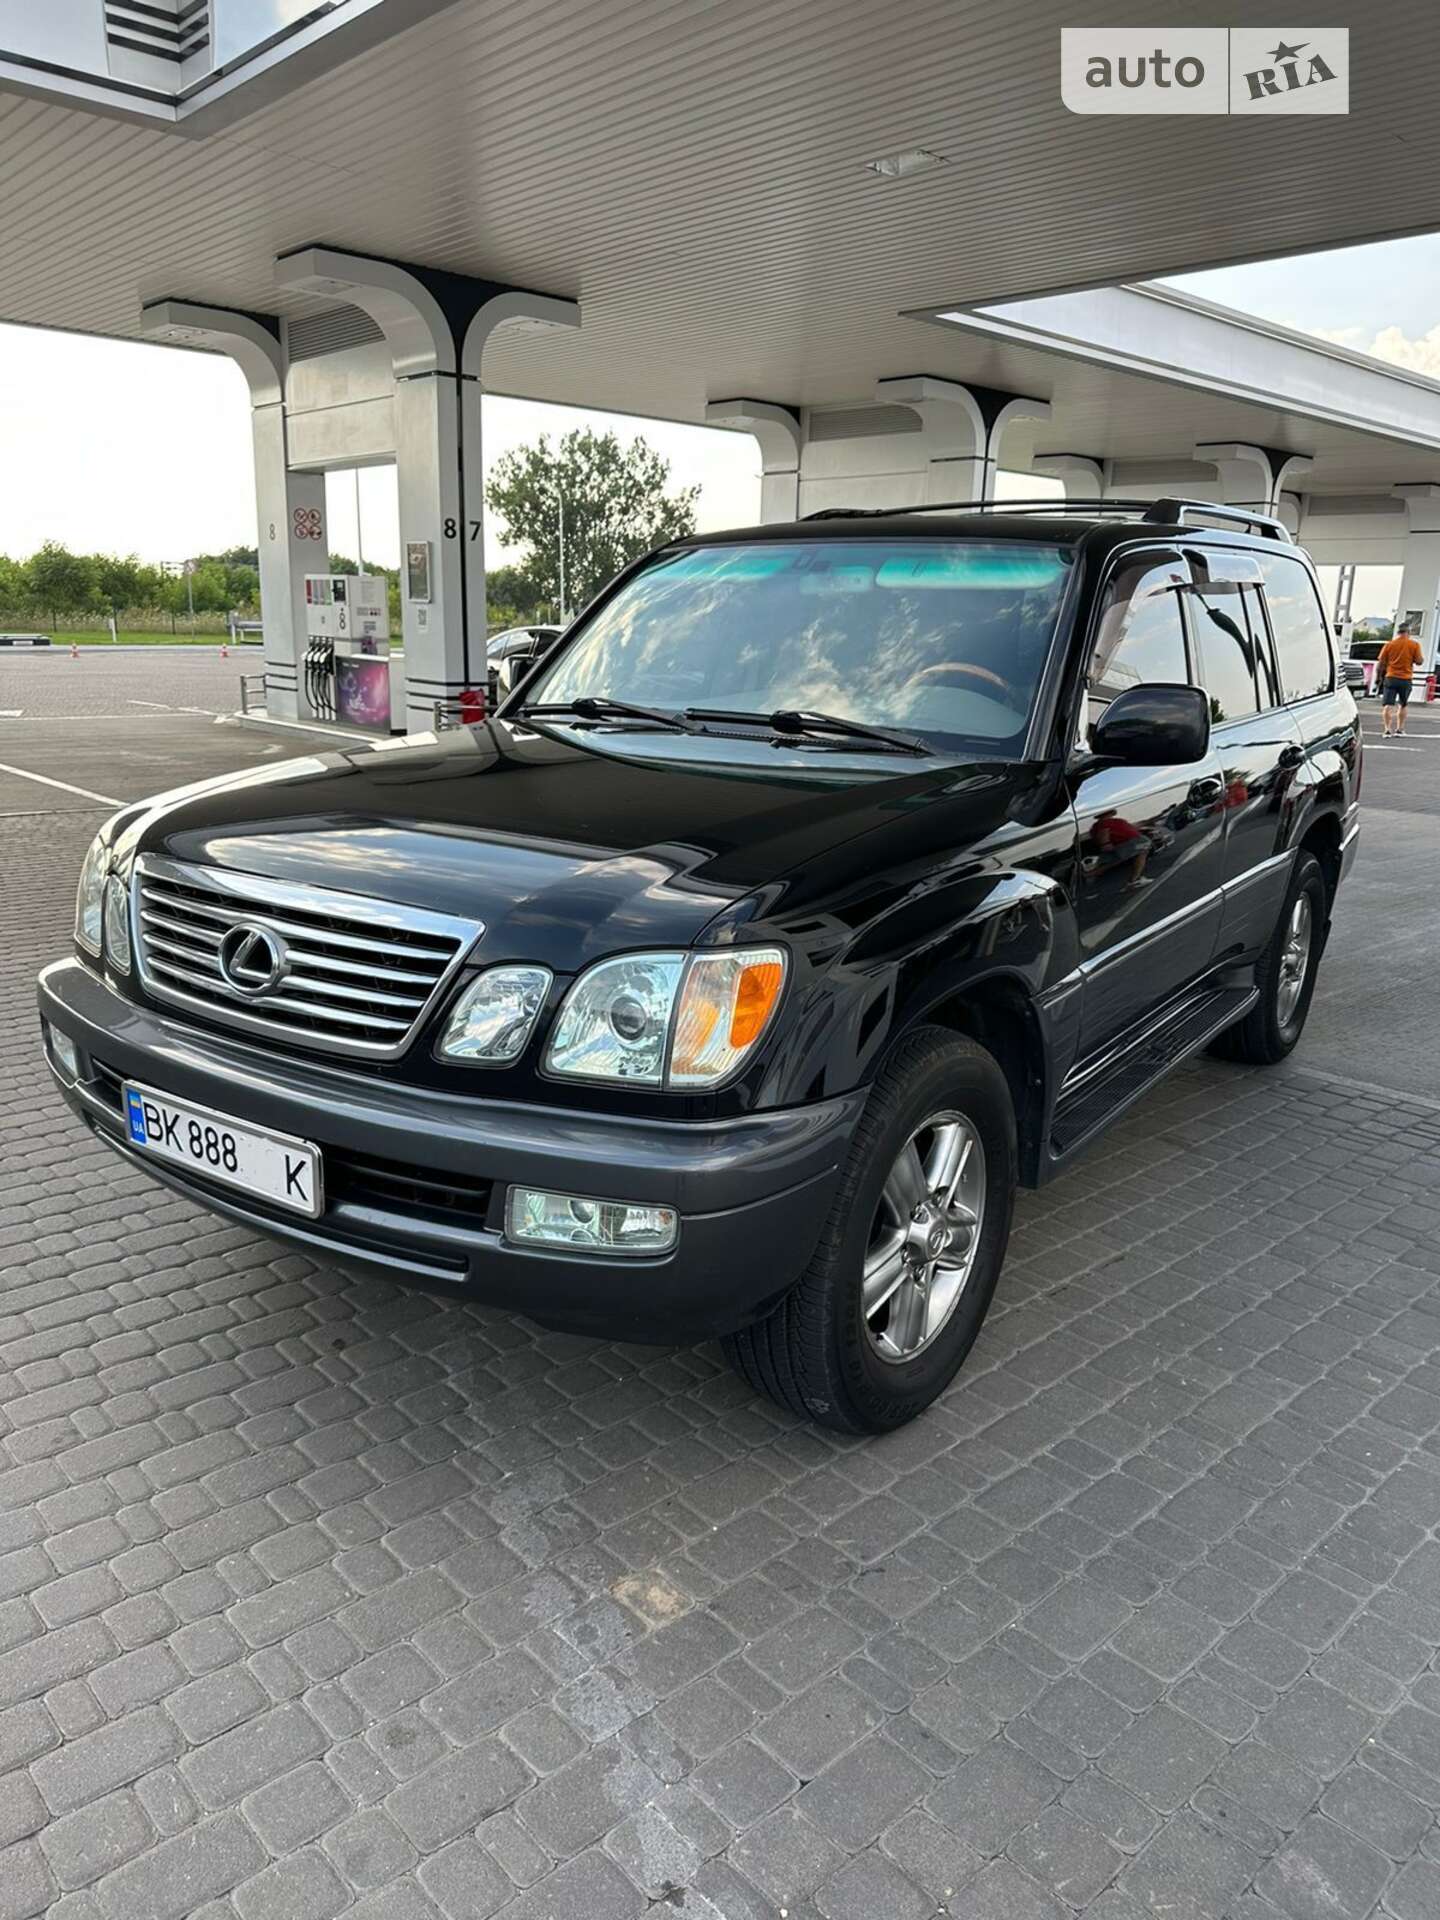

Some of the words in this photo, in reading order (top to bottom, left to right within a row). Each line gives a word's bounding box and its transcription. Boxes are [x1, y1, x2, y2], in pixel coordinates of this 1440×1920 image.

[269, 523, 276, 540] 8
[444, 518, 457, 539] 8
[469, 521, 482, 541] 7
[133, 1119, 145, 1134] UA
[143, 1102, 184, 1152] BK
[188, 1120, 238, 1173] 888
[285, 1154, 308, 1202] K
